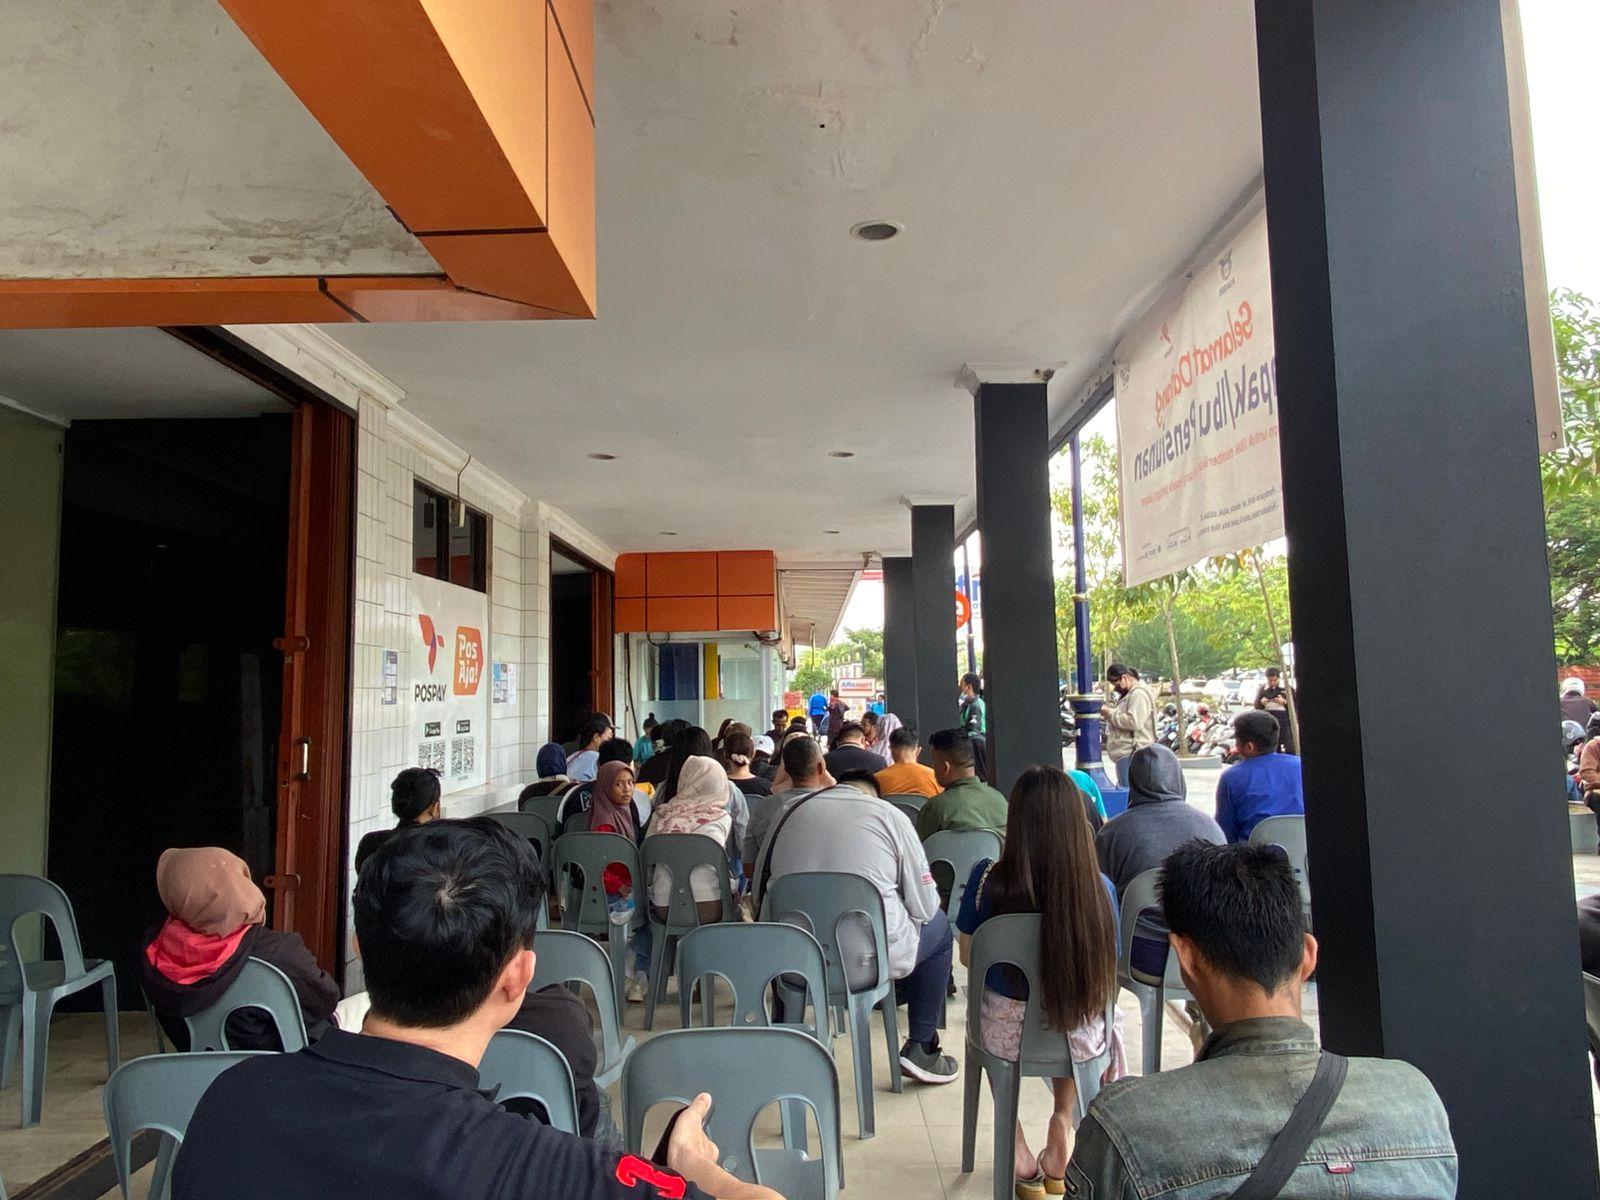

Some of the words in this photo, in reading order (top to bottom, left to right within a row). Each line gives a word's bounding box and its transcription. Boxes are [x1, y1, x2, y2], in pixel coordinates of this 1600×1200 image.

[458, 634, 478, 659] Pos
[458, 660, 478, 689] Aja!
[414, 684, 447, 702] POSPAY
